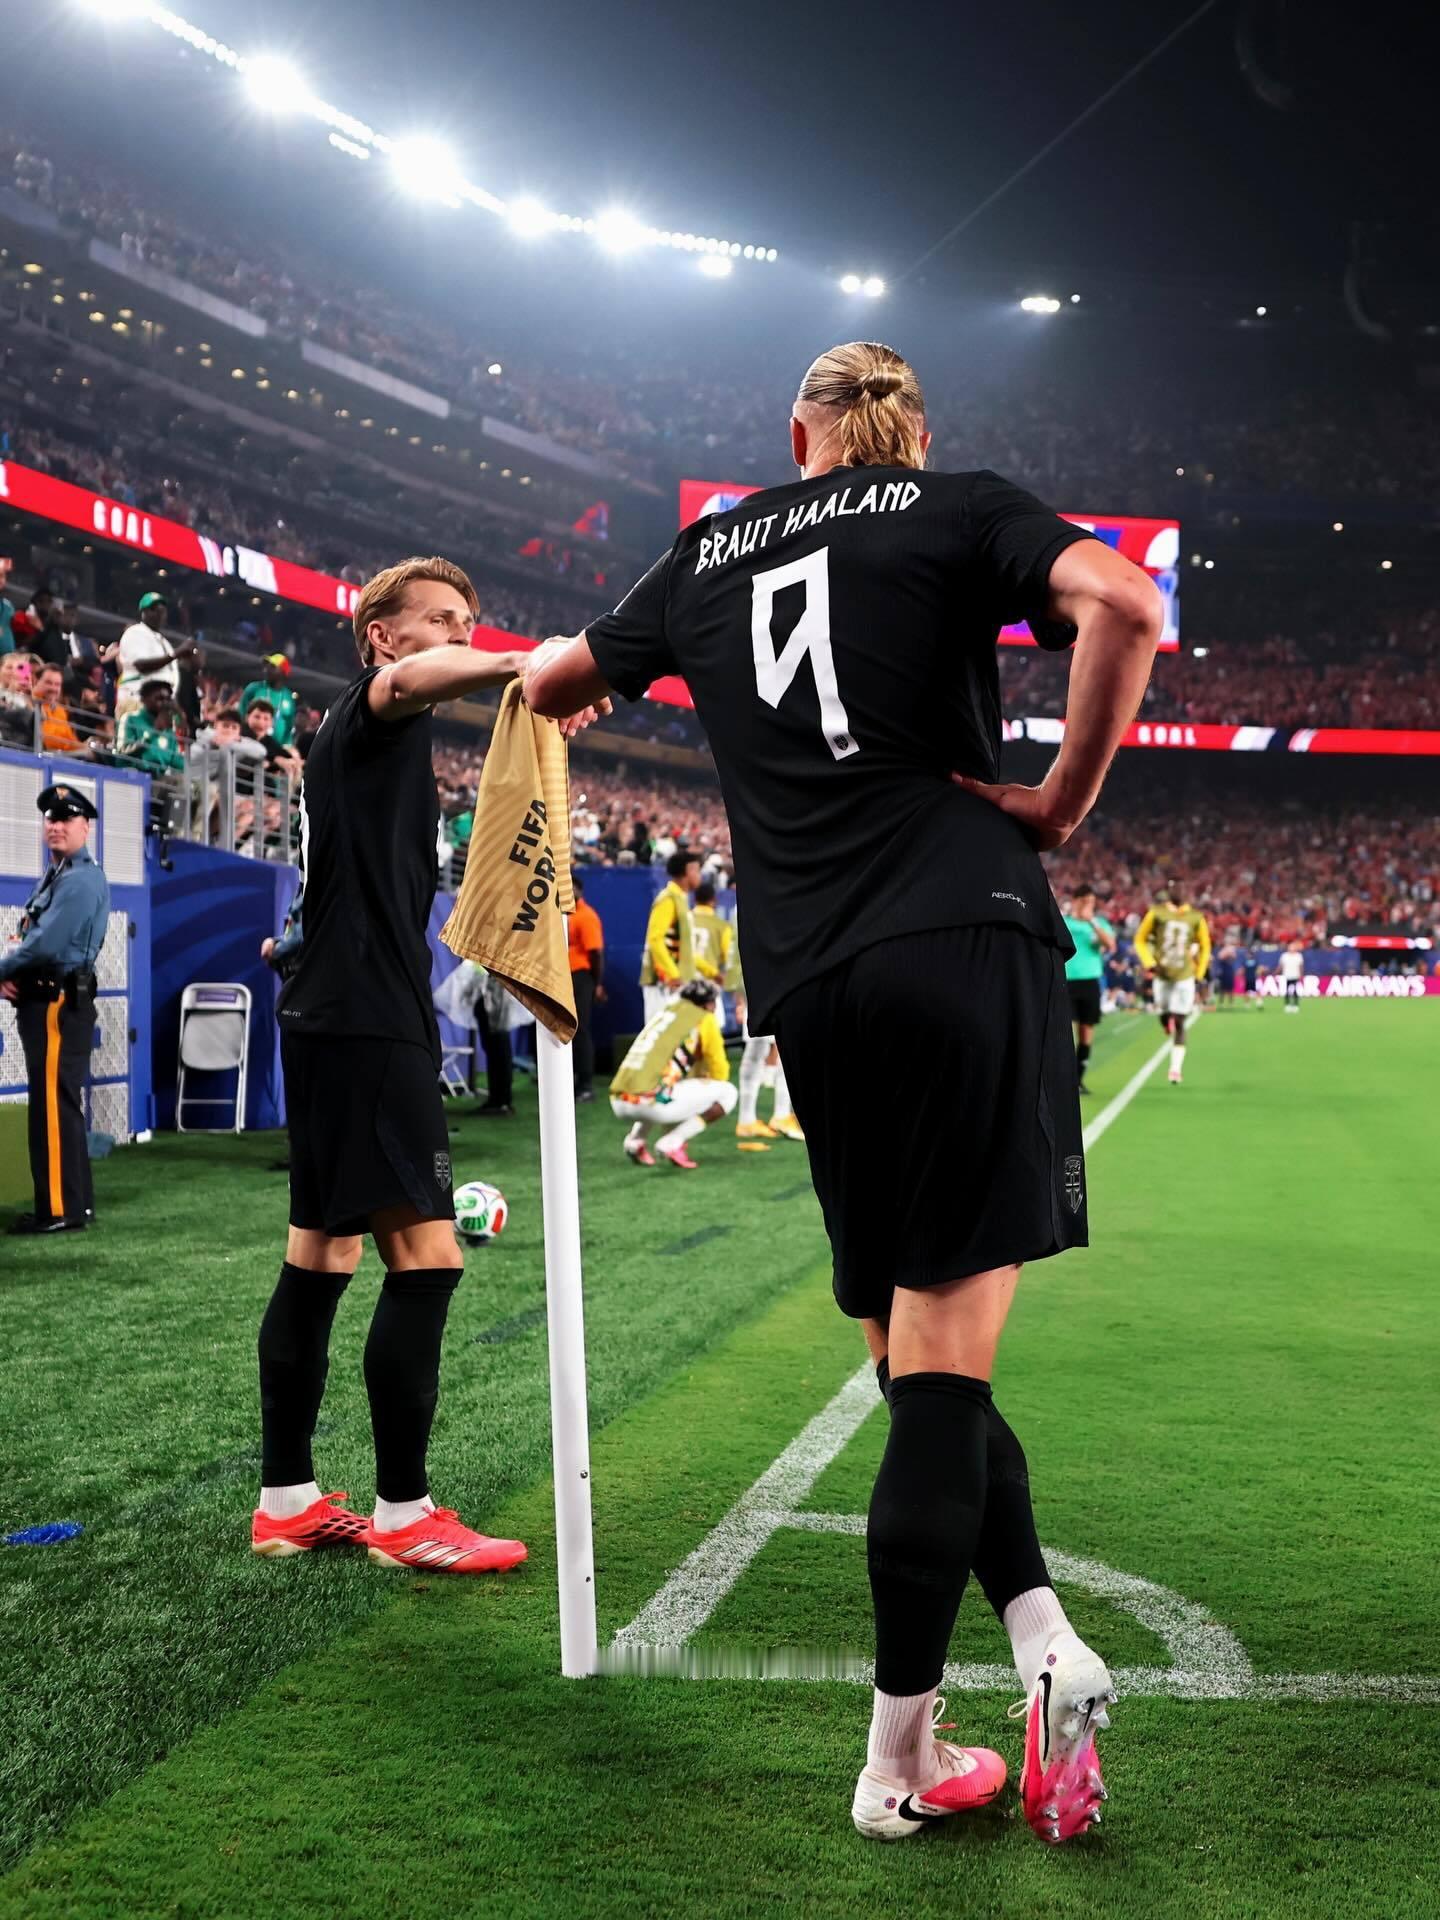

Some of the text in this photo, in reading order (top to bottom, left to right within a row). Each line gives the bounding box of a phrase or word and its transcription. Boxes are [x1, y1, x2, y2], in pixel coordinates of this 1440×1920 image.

[695, 481, 921, 575] BRAUT HAALAND
[751, 545, 860, 761] 9
[509, 799, 548, 867] FIFA
[1325, 974, 1426, 997] AIRWAYS
